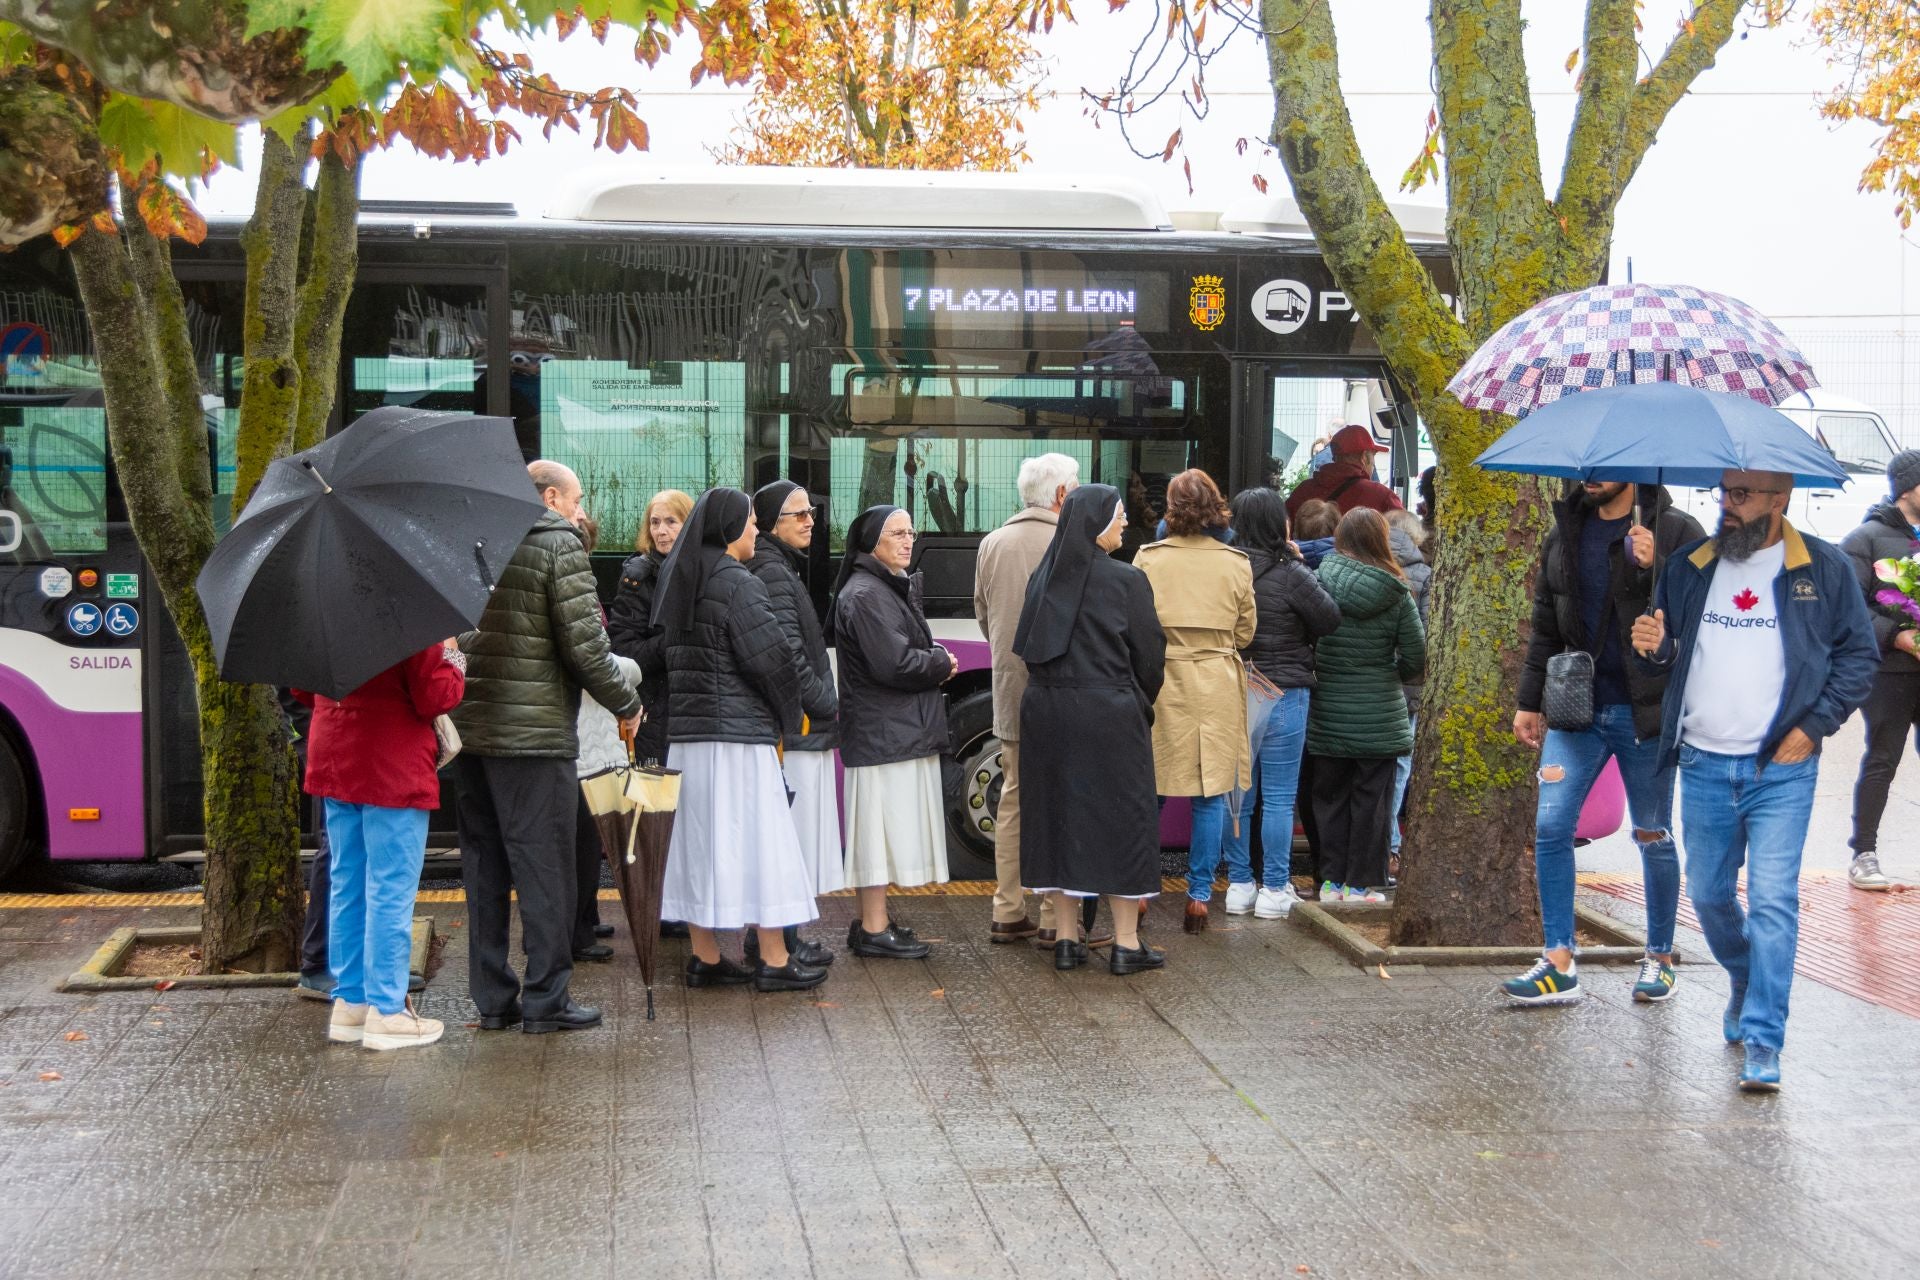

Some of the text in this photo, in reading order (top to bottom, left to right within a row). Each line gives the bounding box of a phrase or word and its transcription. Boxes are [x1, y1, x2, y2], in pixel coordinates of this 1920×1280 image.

[905, 289, 1134, 313] 7 PLAZA DE LEON
[1702, 610, 1777, 629] dsquared
[70, 656, 132, 669] SALIDA
